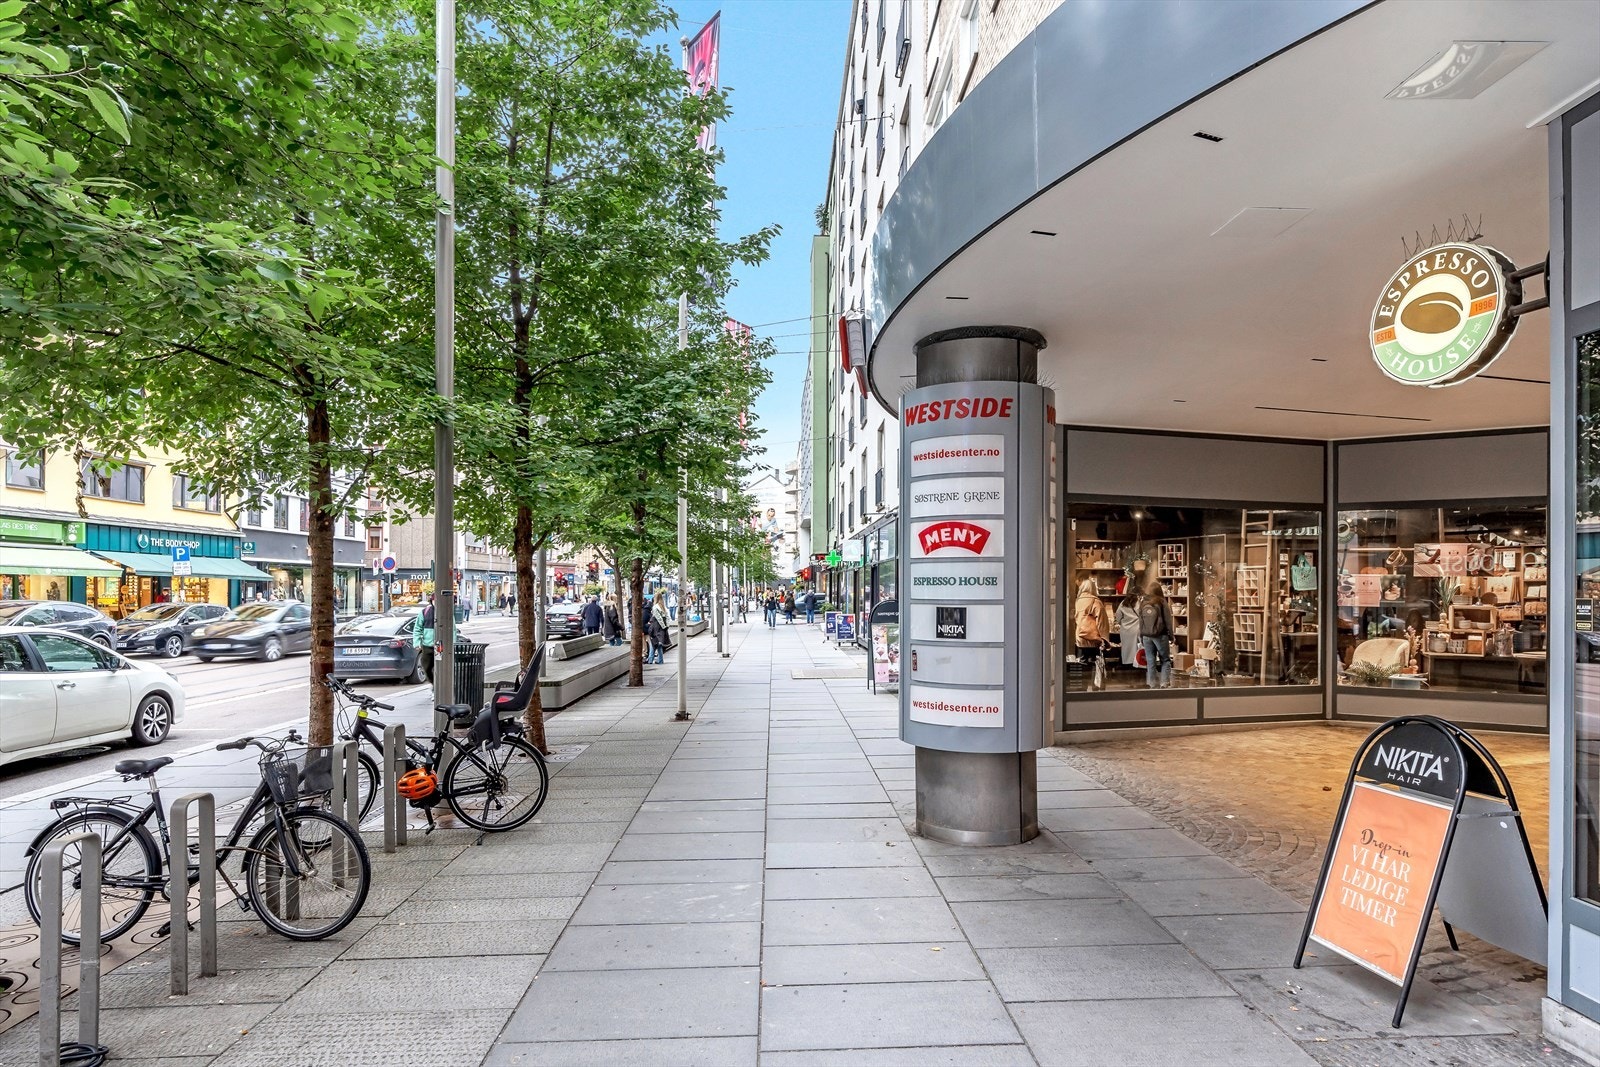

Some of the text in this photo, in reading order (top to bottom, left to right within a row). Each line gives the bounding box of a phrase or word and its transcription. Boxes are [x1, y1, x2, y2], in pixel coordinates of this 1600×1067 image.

[1379, 252, 1490, 318] ESPRESSO
[1474, 299, 1493, 312] 1996
[1376, 331, 1392, 342] ESTD
[1390, 335, 1476, 376] HOUSE
[905, 398, 1014, 427] WESTSIDE
[913, 448, 1000, 462] westsidesenter.no
[914, 491, 1001, 504] SØSTRENE GRENE
[150, 538, 200, 549] THE BODY SHOP
[925, 528, 982, 546] MENY
[176, 548, 186, 560] P
[913, 576, 998, 587] ESPRESSO HOUSE
[937, 624, 964, 634] NIKITA
[912, 700, 999, 714] westsidesenter.no
[1387, 772, 1421, 786] HAIR
[1361, 828, 1412, 859] Drop-in
[1352, 845, 1412, 883] VI HAR
[1340, 865, 1410, 907] LEDIGE
[1340, 886, 1397, 928] TIMER
